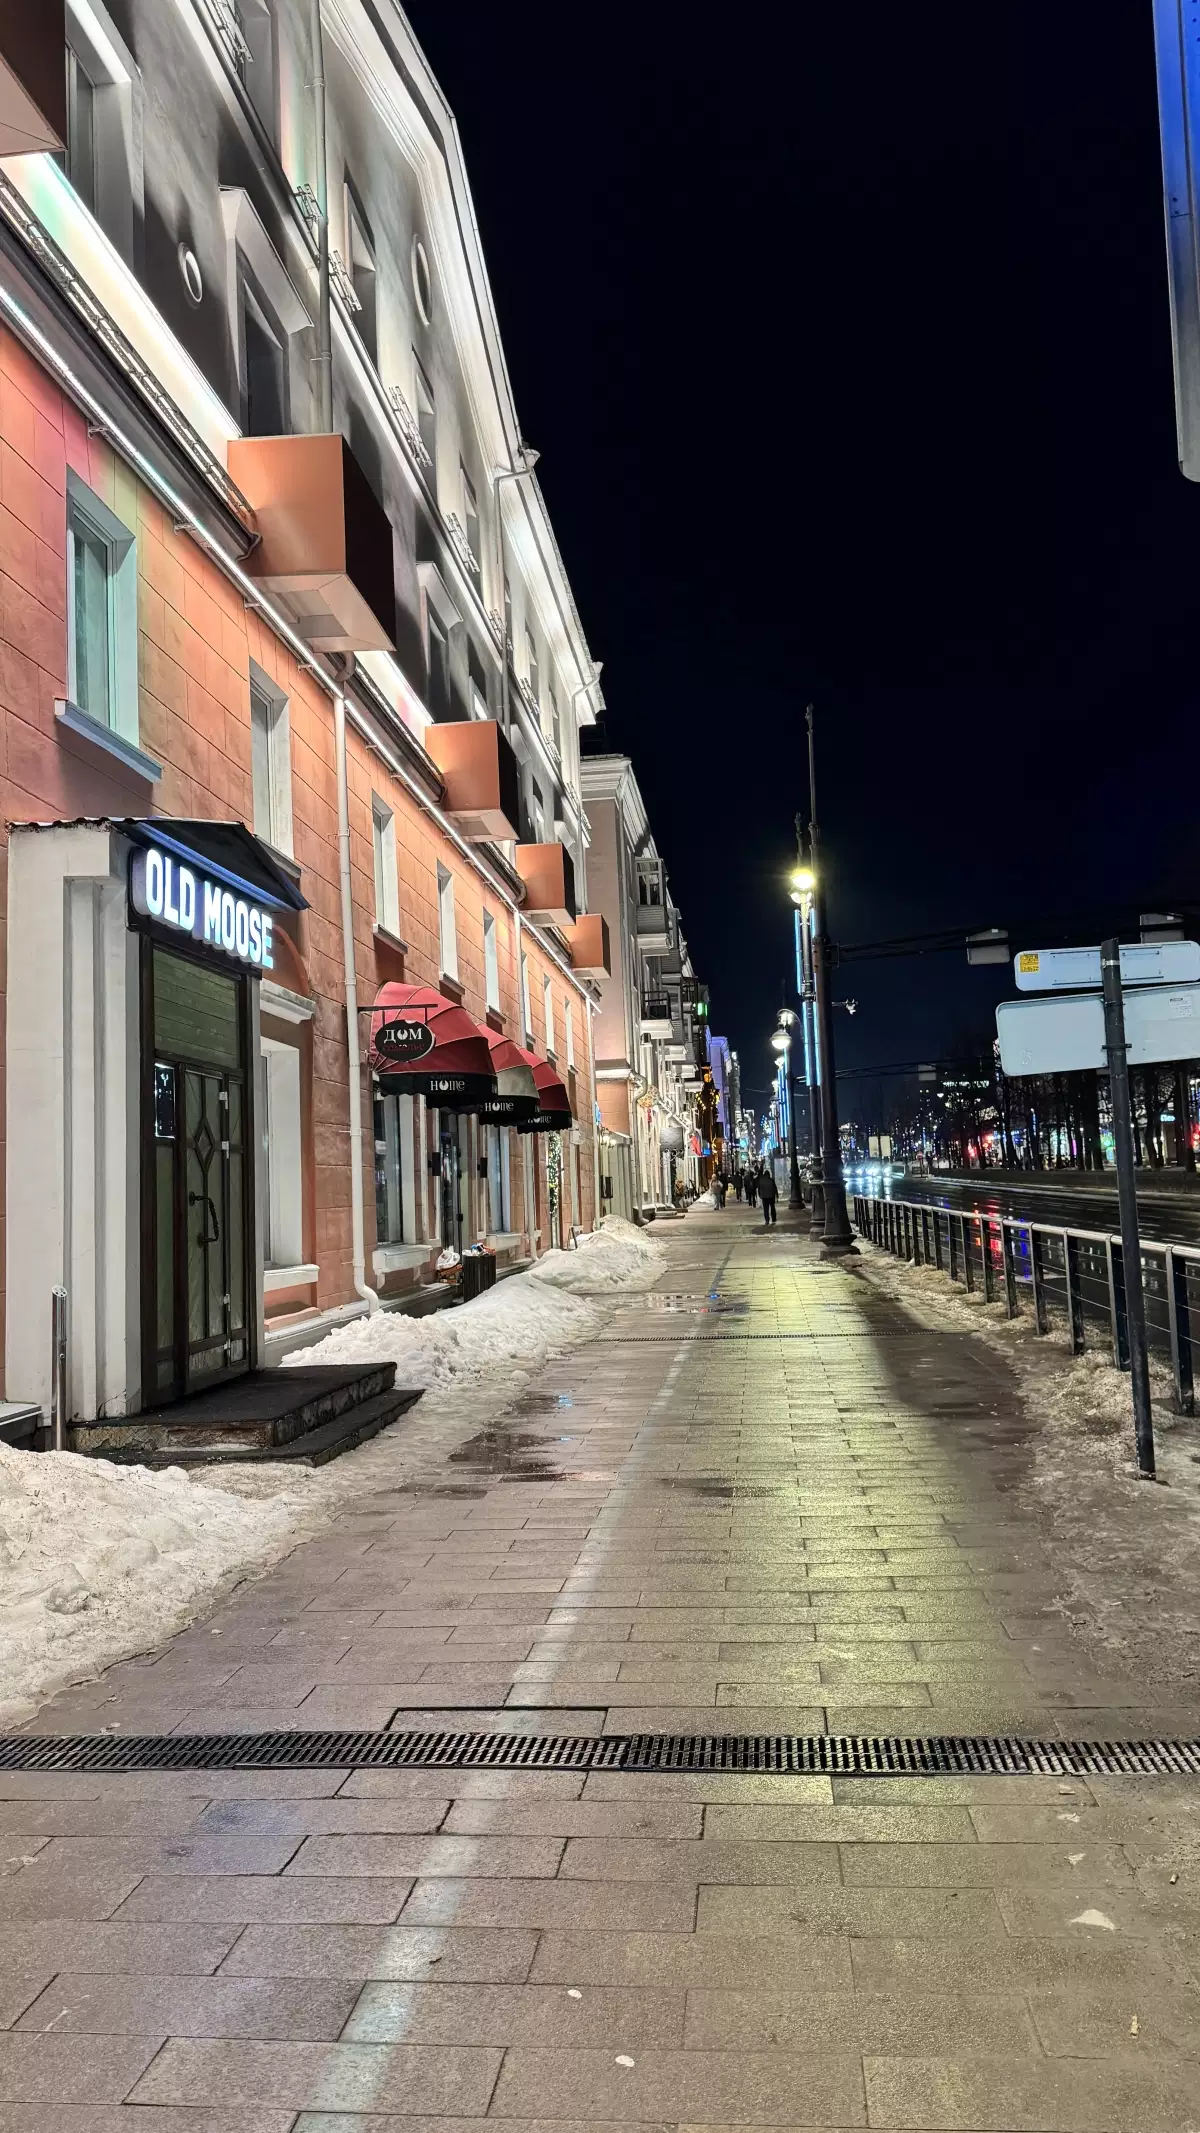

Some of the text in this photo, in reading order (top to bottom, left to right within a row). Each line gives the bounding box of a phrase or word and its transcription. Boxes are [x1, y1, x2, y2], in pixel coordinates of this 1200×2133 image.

[146, 849, 274, 969] OLD MOOSE
[383, 1028, 423, 1044] ДОМ
